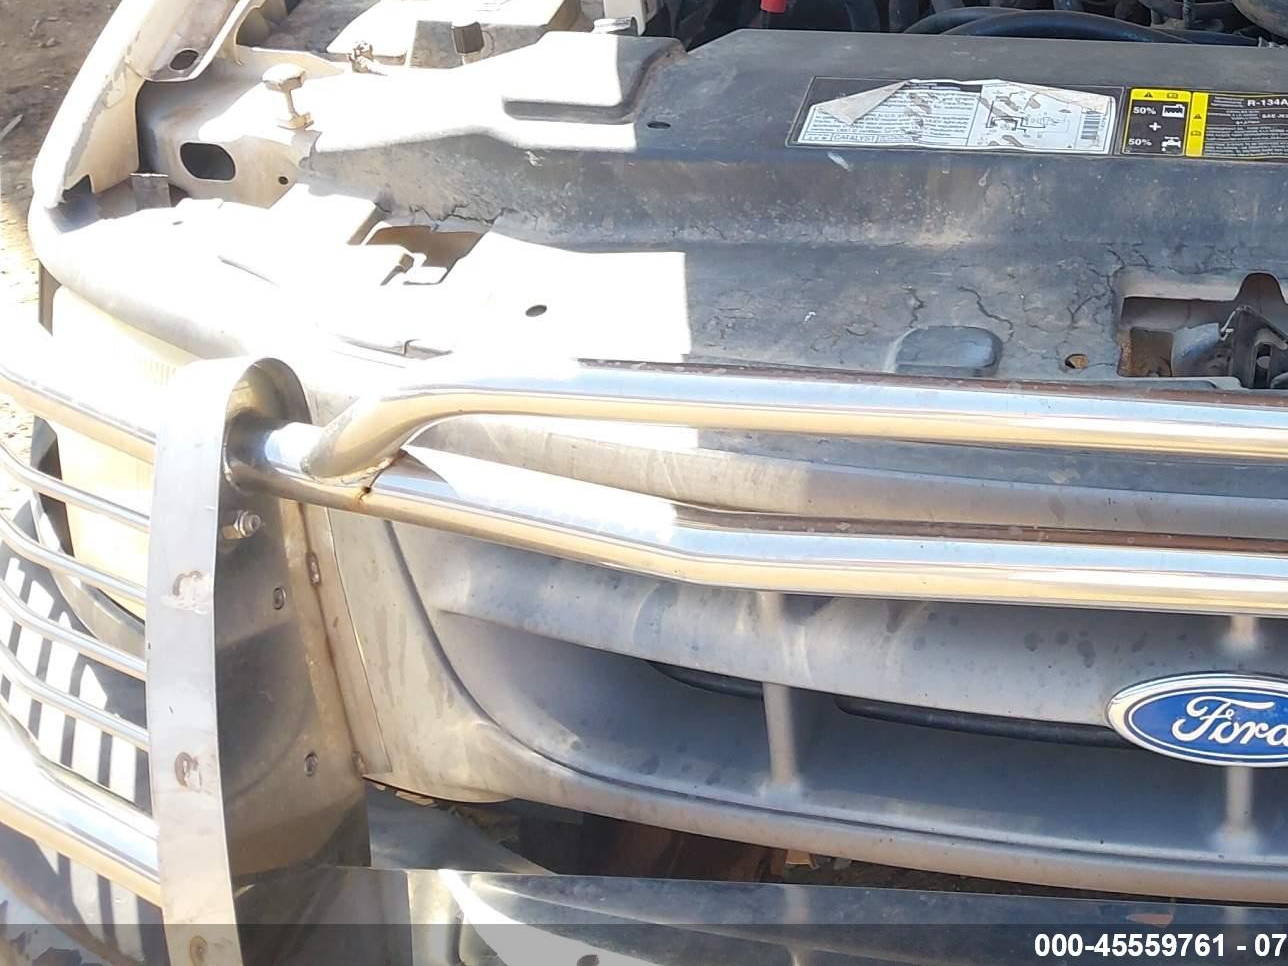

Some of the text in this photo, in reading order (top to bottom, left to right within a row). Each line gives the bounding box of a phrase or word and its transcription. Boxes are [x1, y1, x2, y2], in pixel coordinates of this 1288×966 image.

[1247, 98, 1288, 107] R-134A
[1133, 106, 1157, 115] 50%
[1128, 138, 1152, 146] 50%
